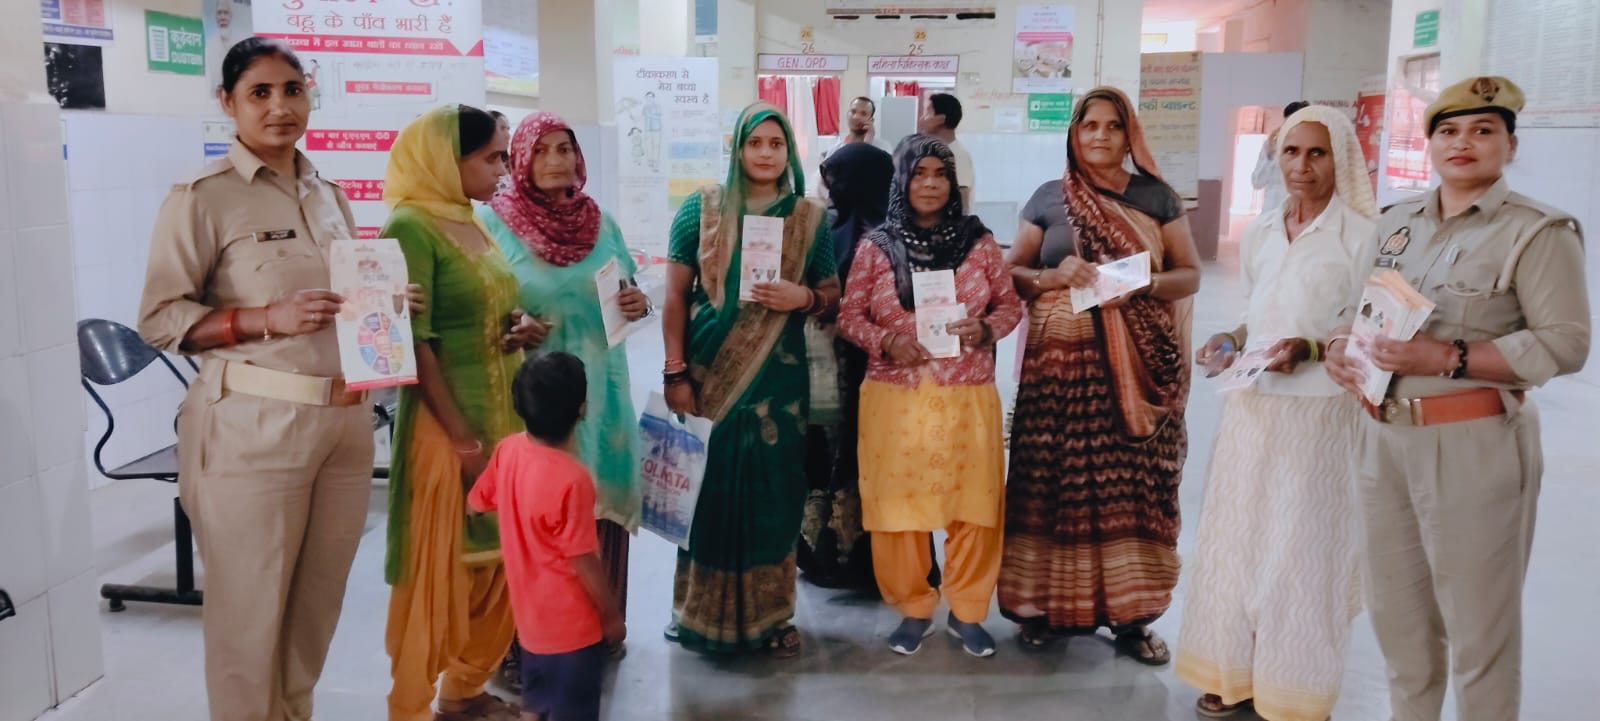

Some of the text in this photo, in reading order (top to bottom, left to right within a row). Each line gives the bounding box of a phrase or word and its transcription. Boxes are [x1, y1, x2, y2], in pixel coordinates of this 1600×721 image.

[287, 13, 315, 32] बहू
[324, 11, 344, 29] के
[395, 15, 428, 32] भारी
[801, 43, 816, 54] 26
[909, 44, 924, 55] 25
[805, 57, 827, 68] OPD
[636, 67, 689, 79] टीकाकरण से
[658, 80, 672, 91] मेरा
[702, 93, 710, 104] है
